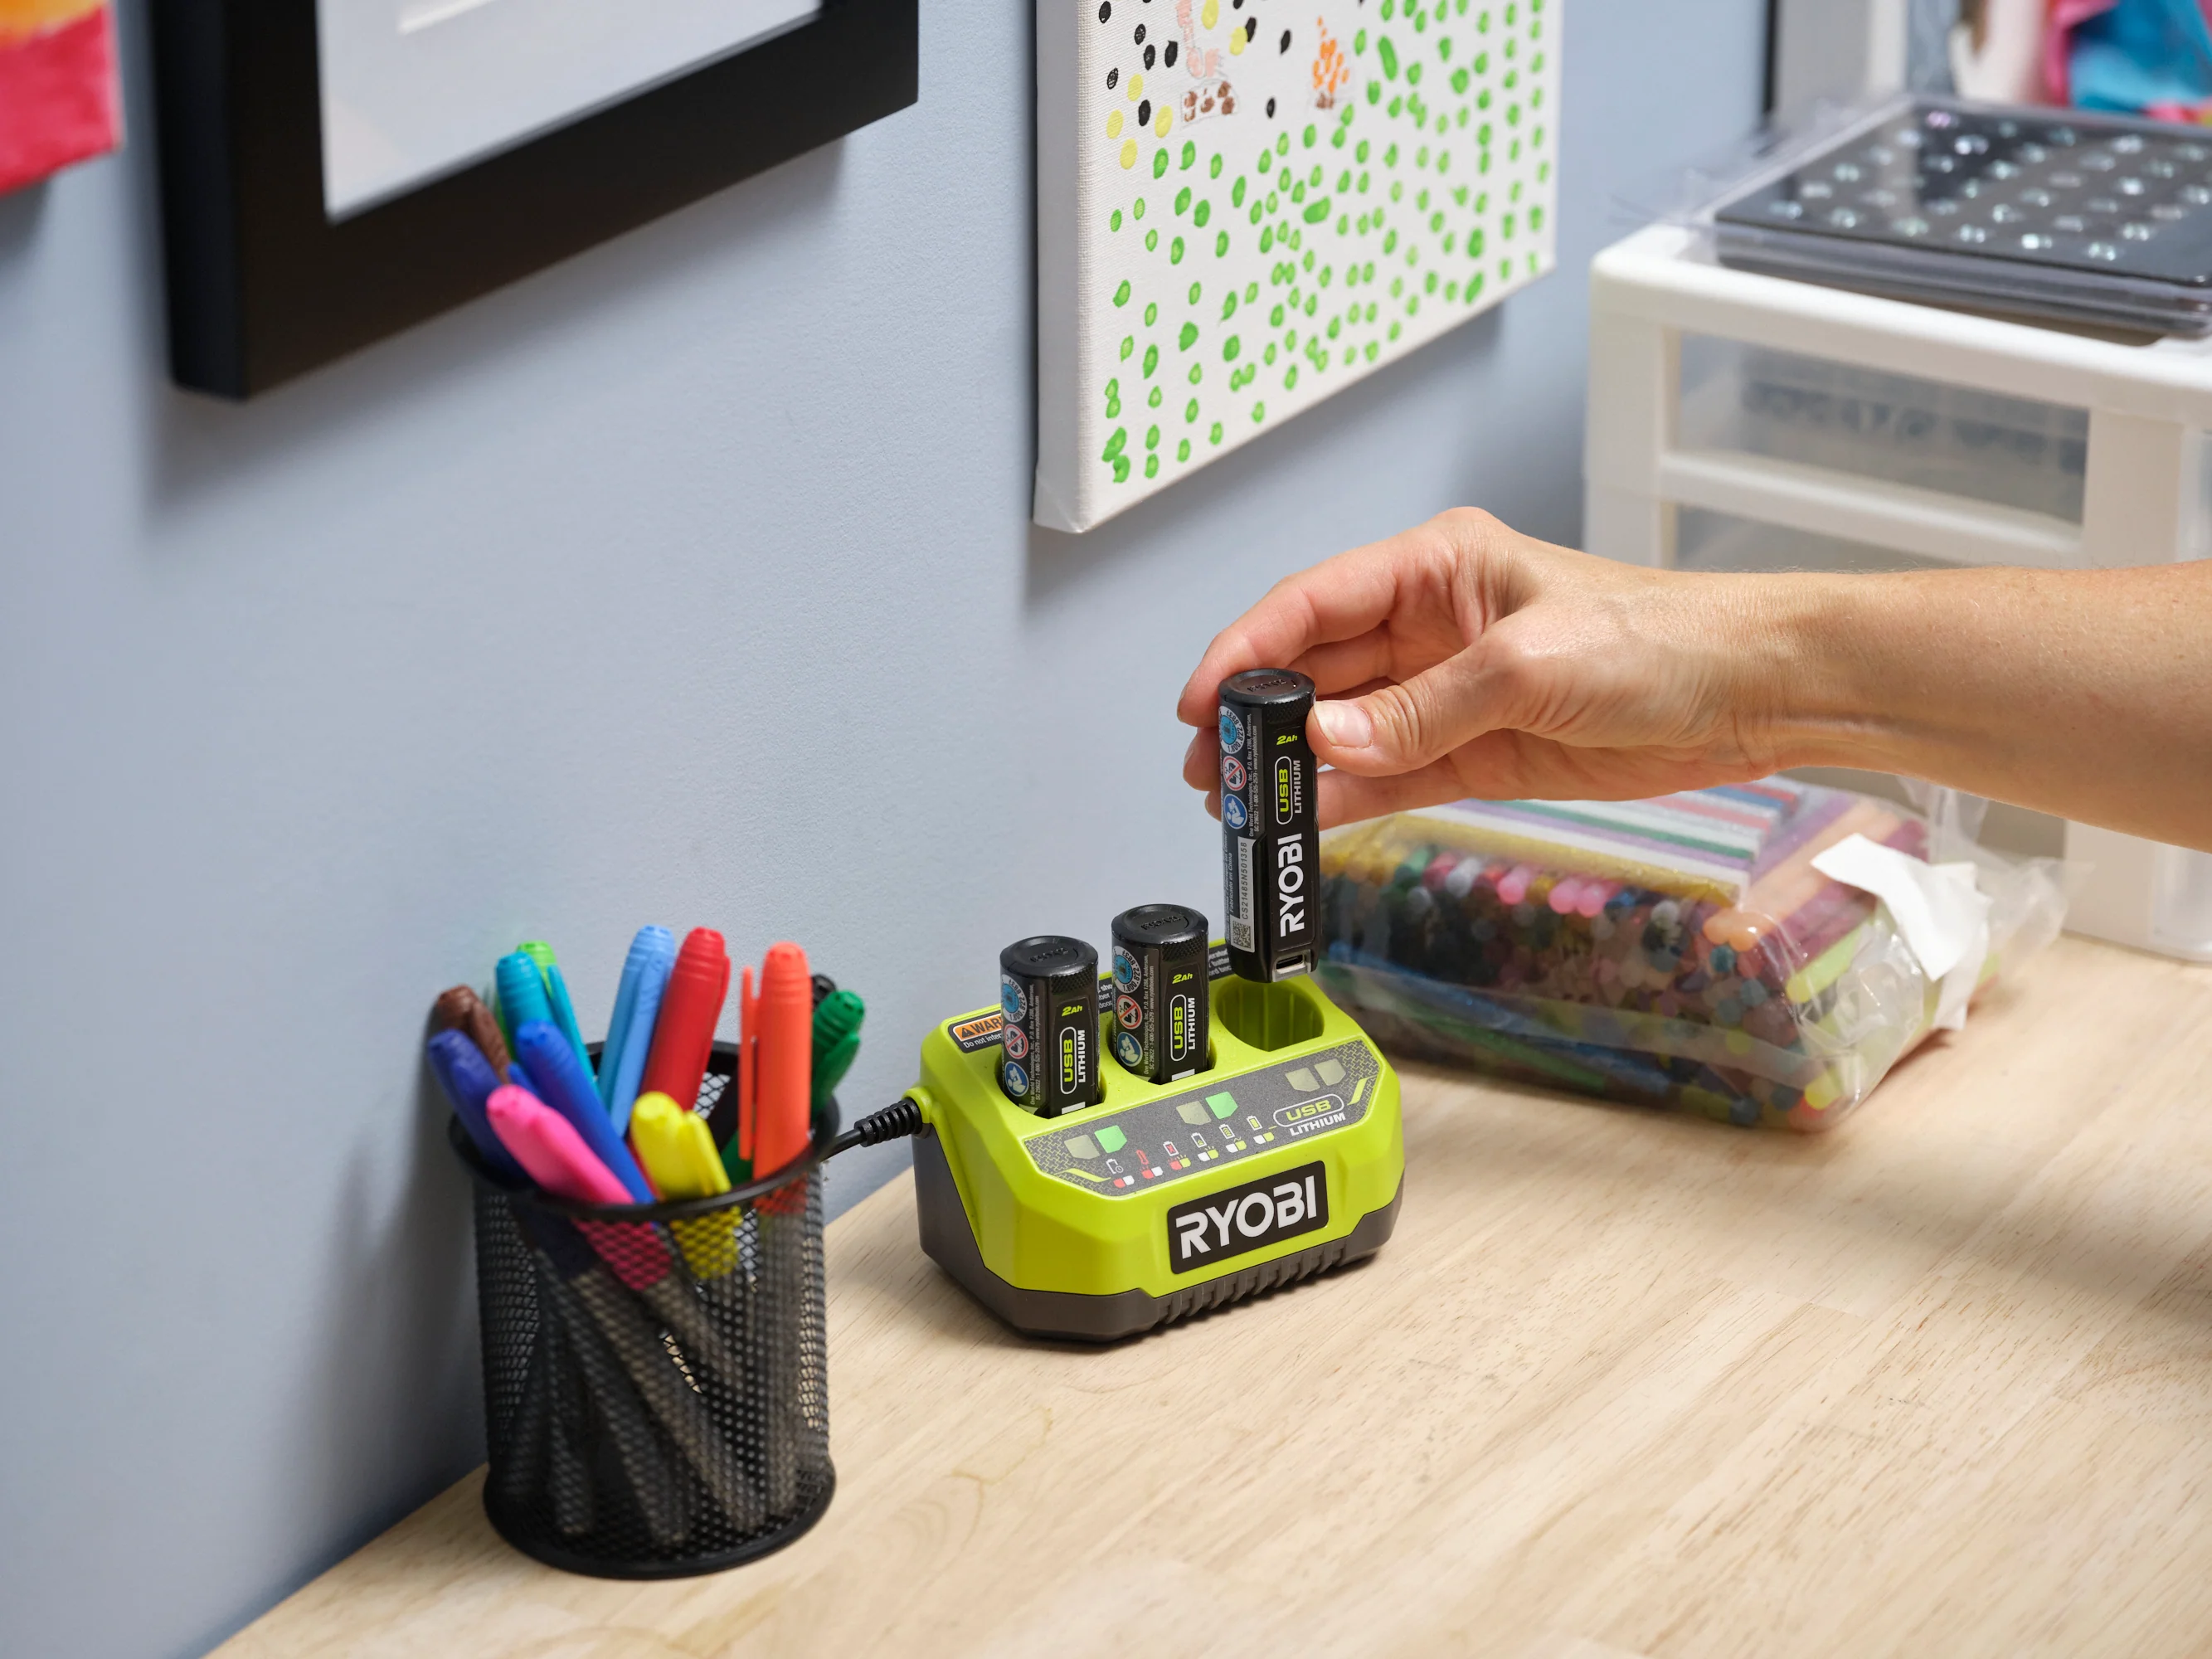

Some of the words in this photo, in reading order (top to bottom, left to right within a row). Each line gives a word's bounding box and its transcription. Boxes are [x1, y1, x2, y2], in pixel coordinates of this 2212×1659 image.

[1276, 734, 1298, 746] 2Ah
[1278, 768, 1289, 813] USB
[1293, 760, 1302, 814] LITHIUM
[1240, 842, 1249, 920] CS21485N501358
[1277, 833, 1305, 937] RYOBI
[1172, 972, 1193, 985] 2Ah
[970, 1016, 1002, 1034] WAR
[1062, 1005, 1083, 1017] 2Ah
[1174, 1006, 1184, 1049] USB
[1187, 997, 1195, 1050] LITHIUM
[963, 1040, 975, 1048] Do
[975, 1036, 987, 1045] not
[985, 1033, 1002, 1042] inter
[1063, 1039, 1074, 1082] USB
[1077, 1029, 1086, 1083] LITHIUM
[1286, 1099, 1331, 1121] USB
[1289, 1112, 1346, 1136] LITHIUM
[1175, 1175, 1317, 1259] RYOBI
